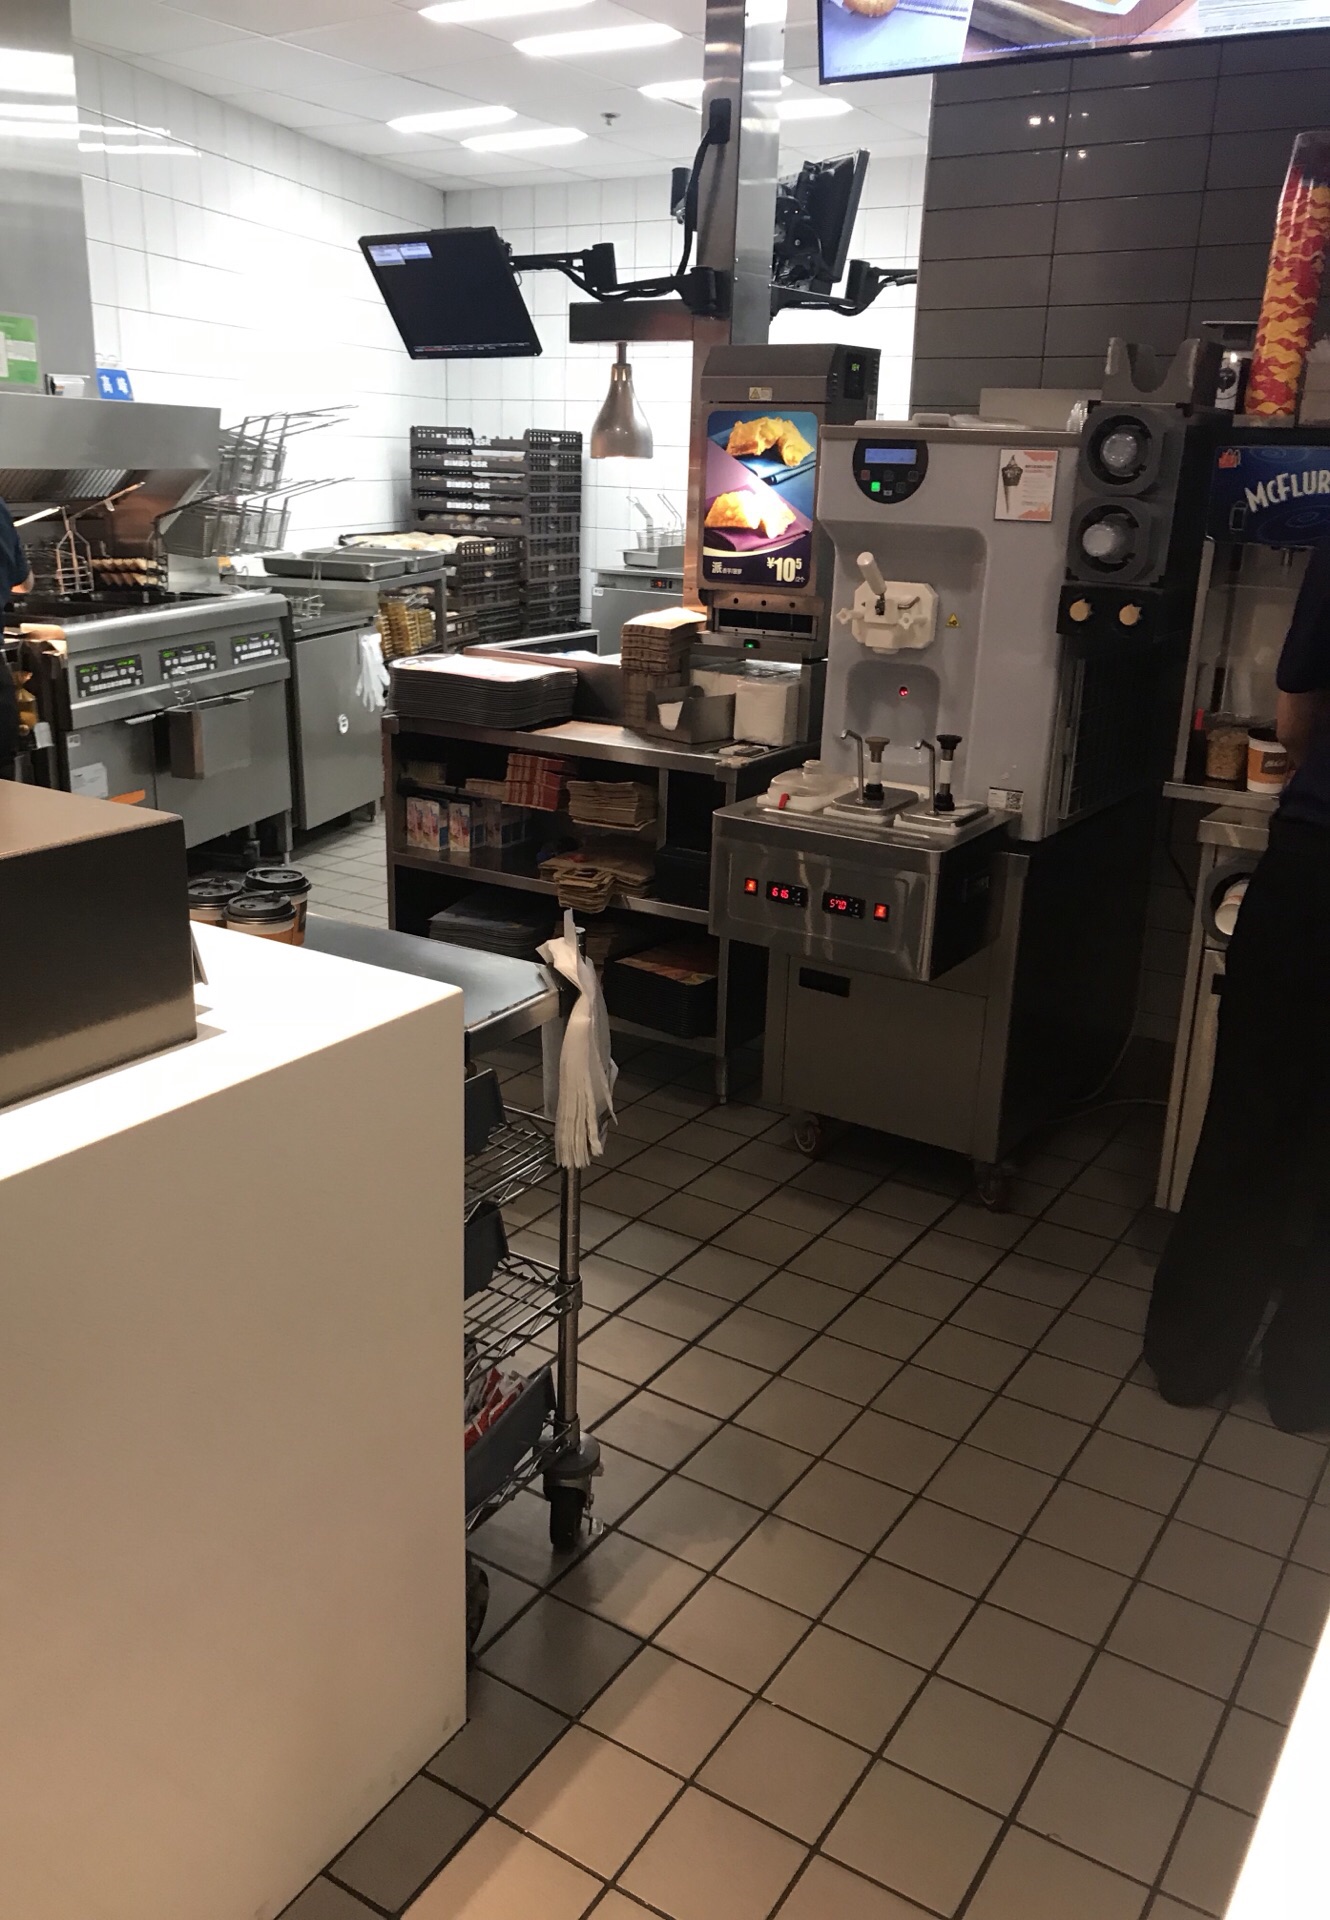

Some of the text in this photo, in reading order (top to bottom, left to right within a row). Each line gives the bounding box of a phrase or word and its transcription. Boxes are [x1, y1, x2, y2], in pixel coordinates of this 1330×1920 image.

[474, 438, 491, 446] QSR
[446, 481, 490, 490] BIMBO QSR
